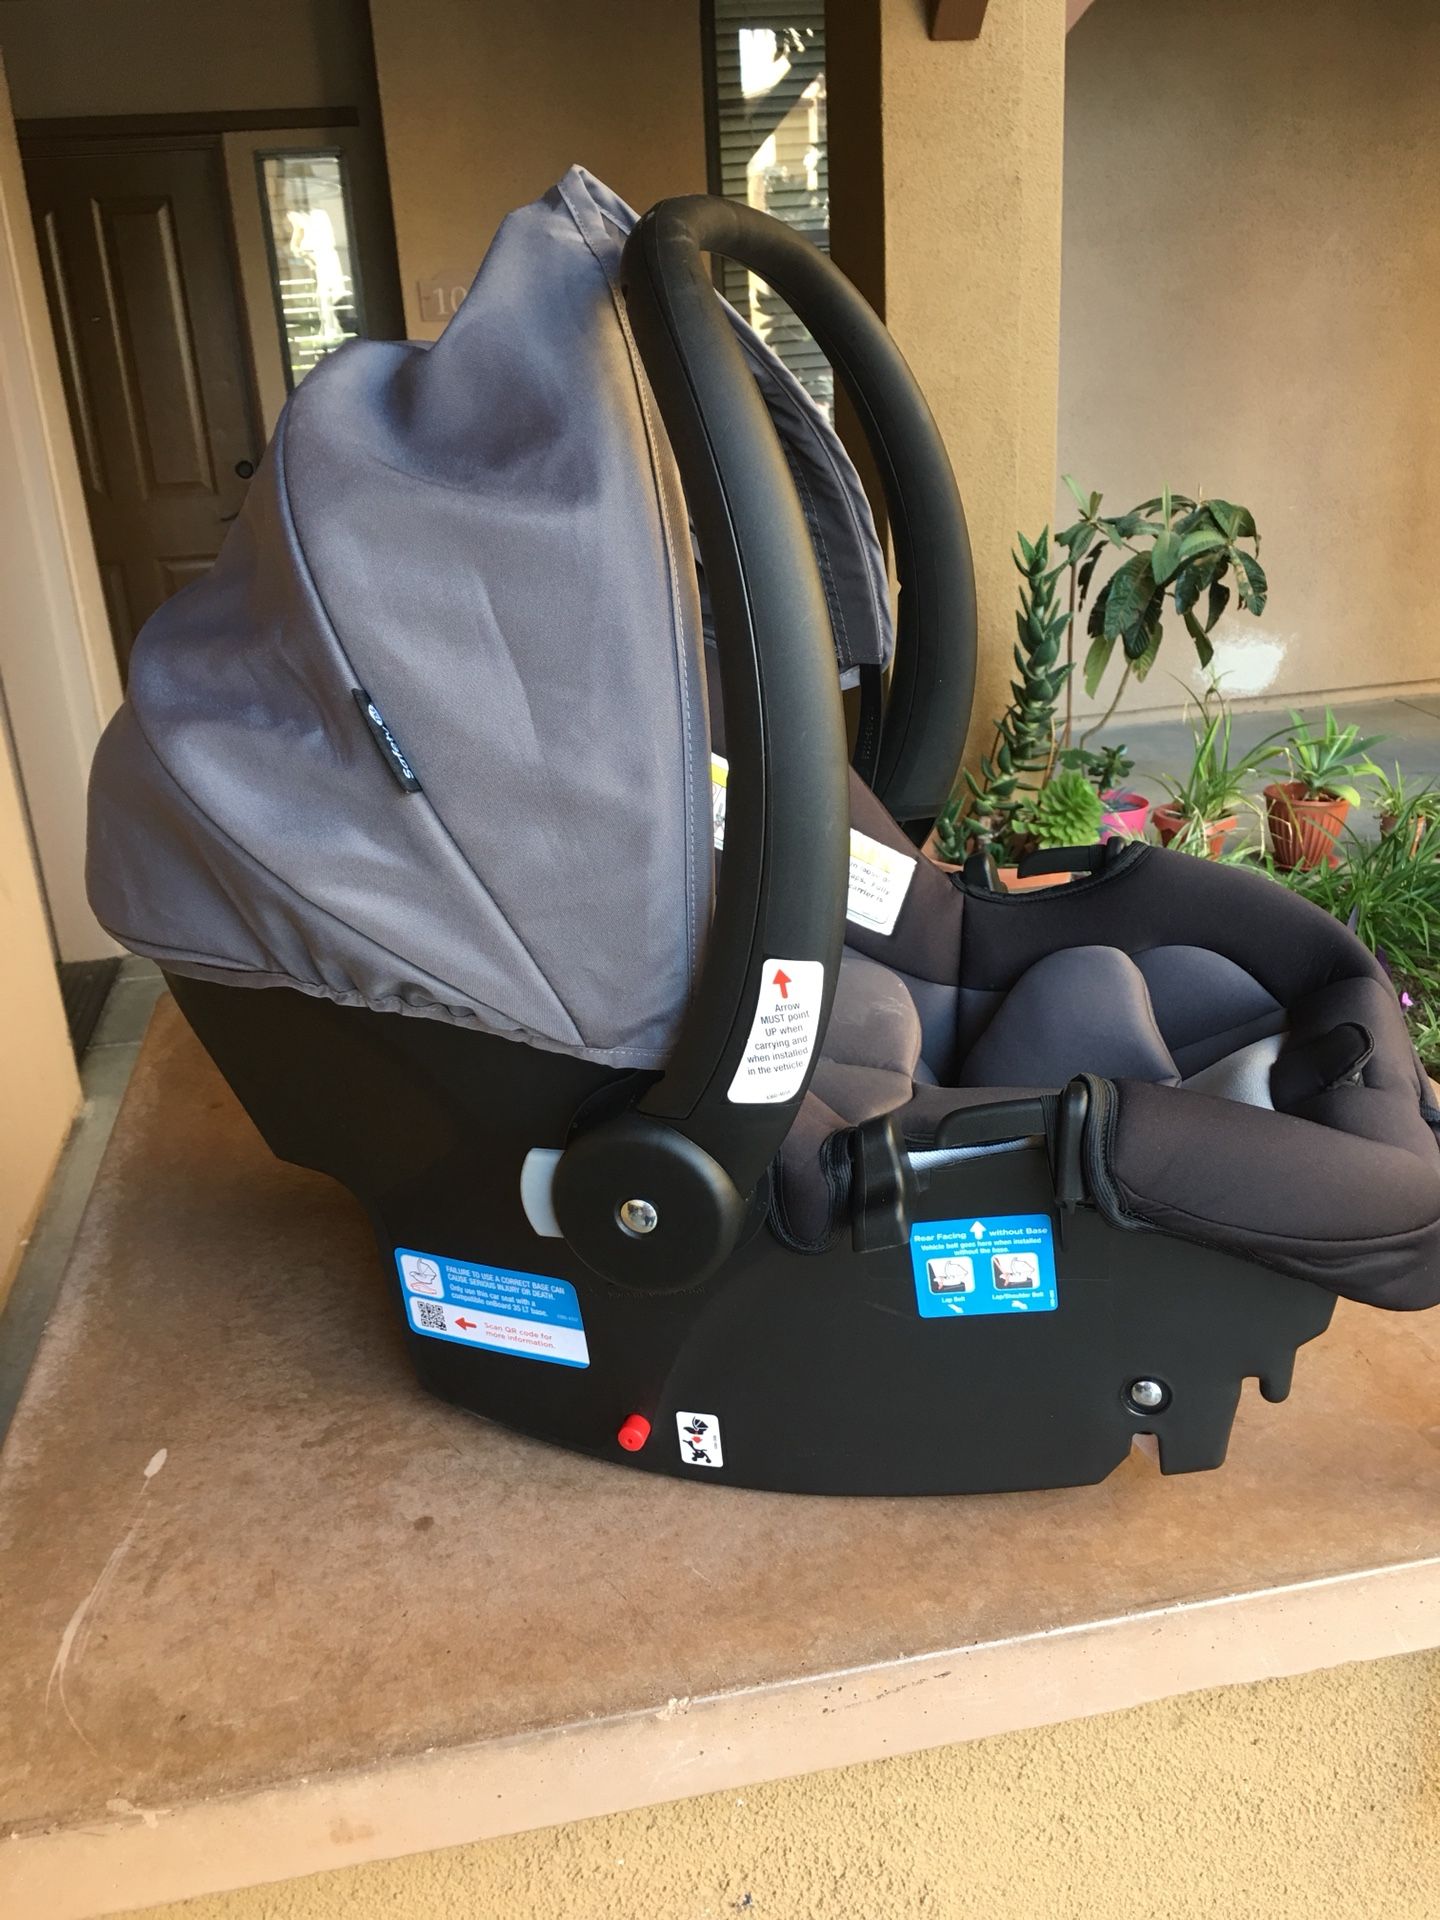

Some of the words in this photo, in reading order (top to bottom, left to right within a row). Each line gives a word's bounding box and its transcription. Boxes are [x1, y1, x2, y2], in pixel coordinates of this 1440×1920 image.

[775, 1003, 801, 1013] Arrow
[760, 1014, 785, 1025] MUST
[787, 1010, 810, 1023] point
[765, 1027, 777, 1037] UP
[780, 1024, 803, 1036] when
[754, 1038, 791, 1051] carrying
[791, 1035, 808, 1046] and
[746, 1053, 771, 1064] when
[772, 1047, 809, 1060] installed
[747, 1066, 756, 1075] in
[757, 1063, 772, 1074] the
[936, 1232, 967, 1241] Facing
[989, 1228, 1024, 1236] without
[1025, 1227, 1048, 1235] Base
[920, 1244, 945, 1252] Vehicle
[945, 1242, 959, 1250] belt
[1013, 1237, 1042, 1245] installed
[446, 1265, 471, 1277] FAILURE
[471, 1270, 481, 1279] TO
[480, 1272, 495, 1282] USE
[500, 1276, 531, 1288] CORRECT
[531, 1281, 551, 1292] BASE
[550, 1285, 566, 1295] CAN
[447, 1273, 469, 1285] CAUSE
[468, 1277, 497, 1290] SERIOUS
[496, 1283, 521, 1294] INJURY
[521, 1287, 532, 1296] OR
[532, 1289, 556, 1301] DEATH.
[449, 1283, 464, 1294] Only
[464, 1288, 476, 1296] use
[476, 1289, 489, 1298] this
[489, 1293, 500, 1301] car
[500, 1295, 515, 1304] seat
[515, 1297, 531, 1306] with
[450, 1292, 486, 1306] compatible
[521, 1304, 530, 1313] LT
[484, 1322, 503, 1331] Scan
[504, 1326, 517, 1334] QR
[519, 1330, 539, 1338] code
[540, 1332, 553, 1340] for
[485, 1331, 506, 1340] more
[507, 1334, 556, 1349] information.
